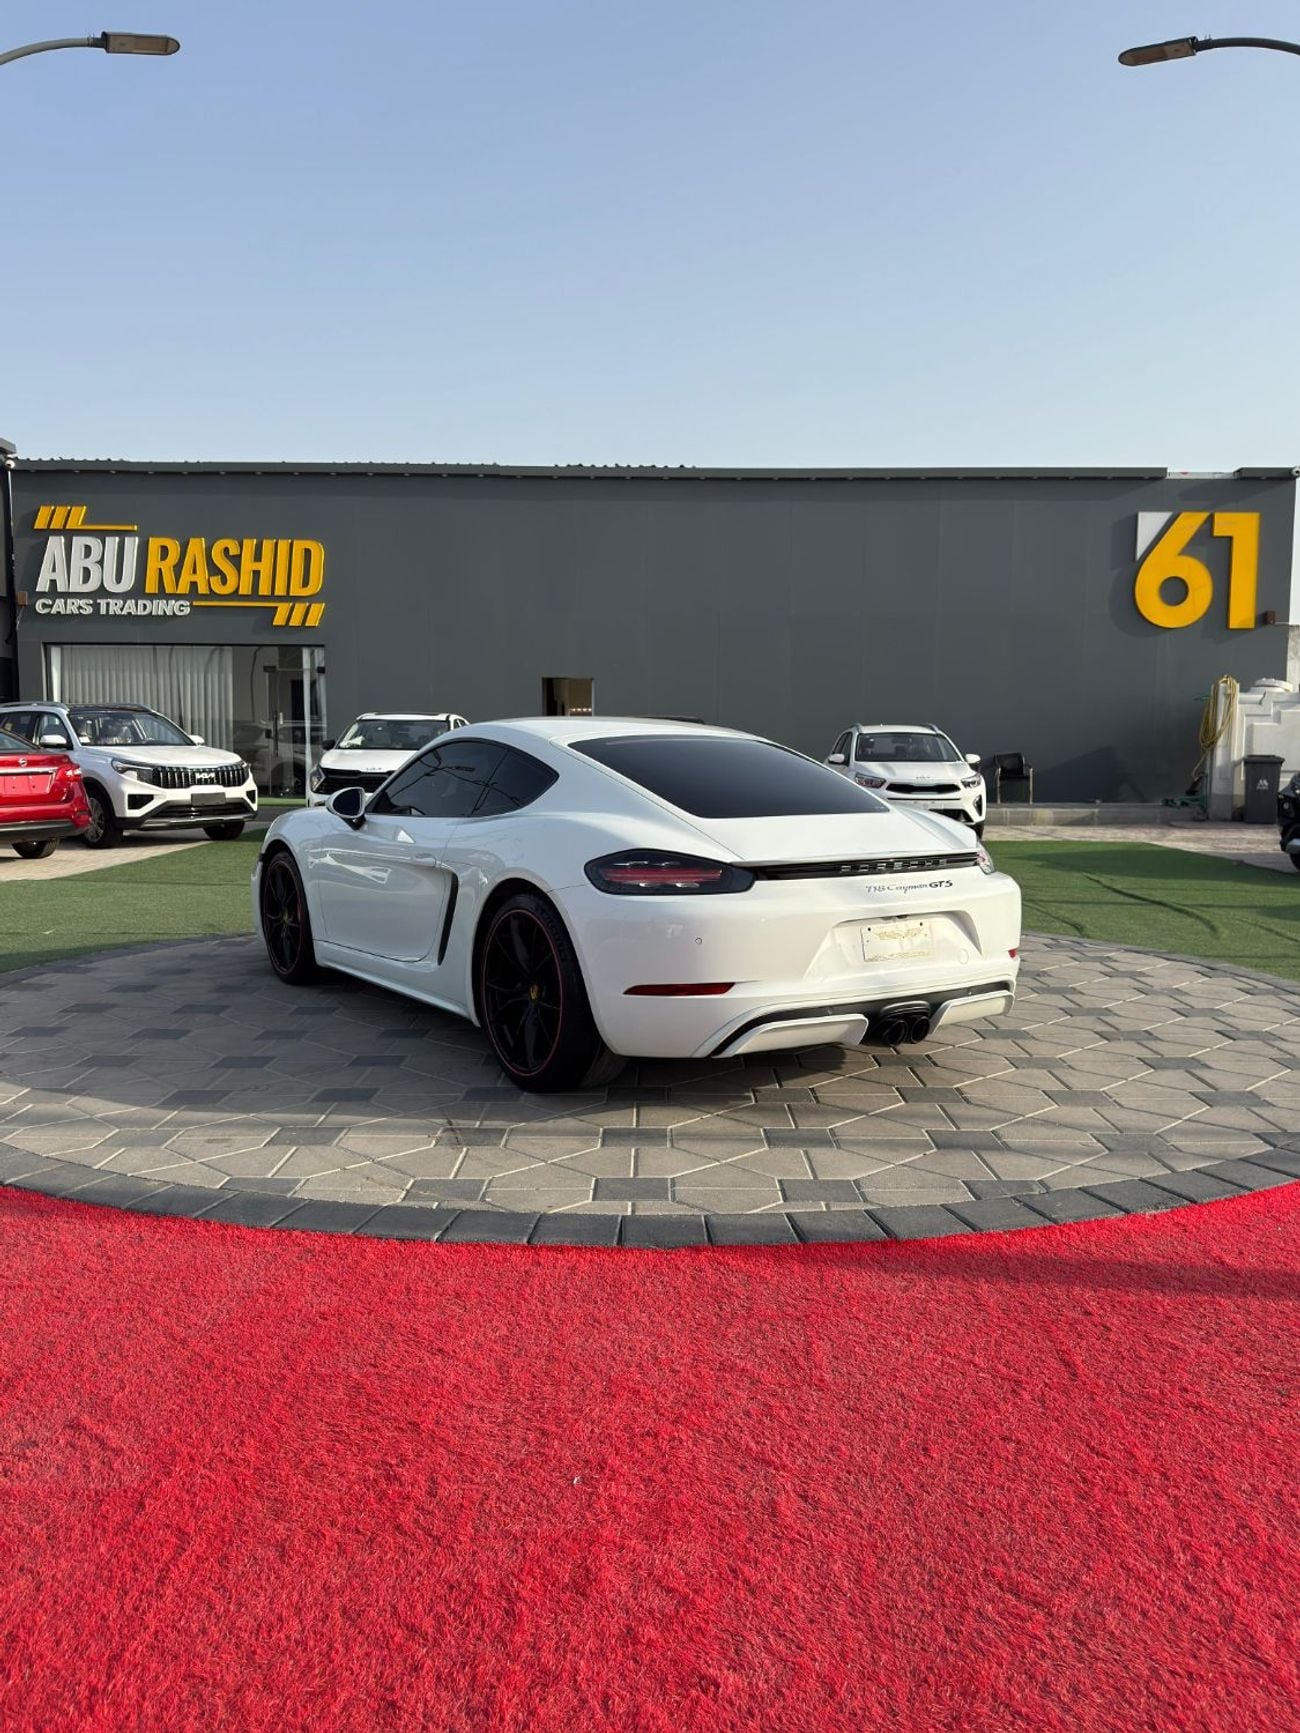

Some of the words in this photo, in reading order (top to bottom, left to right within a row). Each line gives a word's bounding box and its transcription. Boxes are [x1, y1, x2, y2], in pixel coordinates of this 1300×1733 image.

[36, 536, 138, 592] ABU
[145, 537, 325, 596] RASHID
[1135, 511, 1261, 629] 61
[35, 599, 93, 615] CARS
[97, 599, 190, 616] TRADING
[929, 880, 953, 888] GTS
